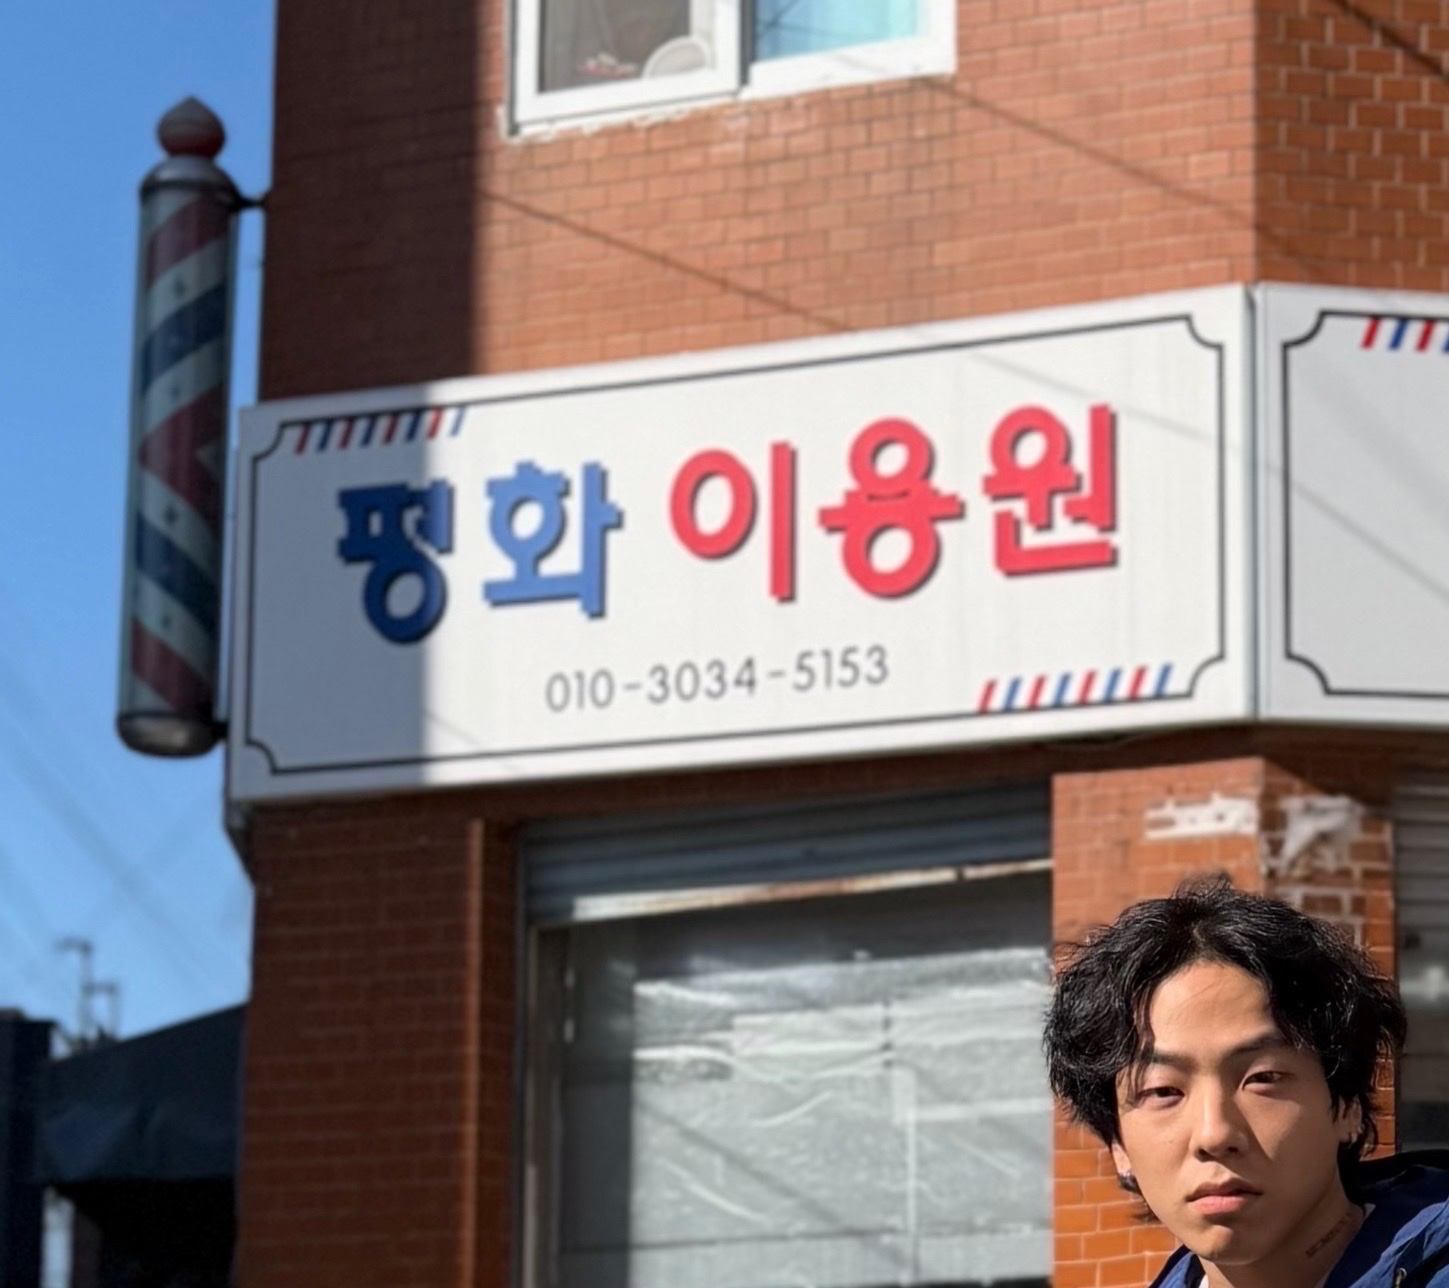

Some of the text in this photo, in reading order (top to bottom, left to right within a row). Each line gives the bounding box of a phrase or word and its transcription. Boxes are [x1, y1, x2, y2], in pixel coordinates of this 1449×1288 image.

[337, 404, 1119, 645] 평화 이용원
[545, 644, 891, 715] 010-3034-5153
